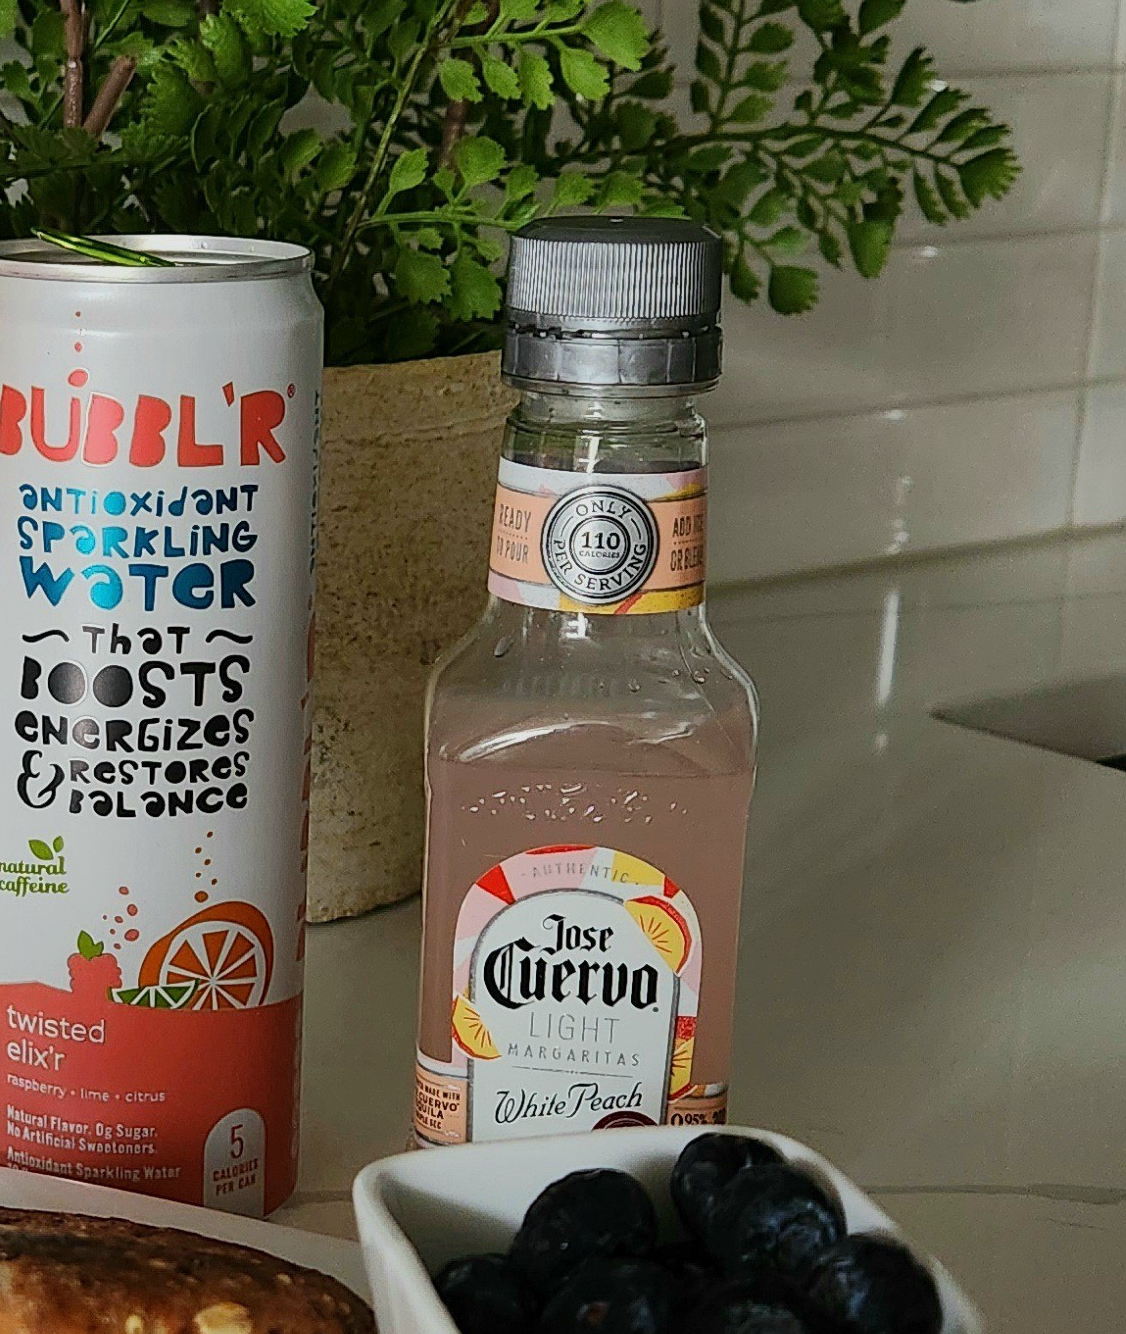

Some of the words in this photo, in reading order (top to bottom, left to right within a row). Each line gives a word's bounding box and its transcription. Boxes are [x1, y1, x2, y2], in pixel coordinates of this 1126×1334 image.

[499, 503, 532, 533] READY
[575, 499, 632, 520] ONLY
[581, 531, 621, 550] 110
[672, 515, 692, 538] ADD
[504, 539, 529, 564] POUR
[553, 539, 573, 576] PER
[573, 543, 647, 591] SERVING
[578, 550, 621, 559] CALORIES
[20, 655, 251, 708] BOOSTS
[532, 862, 631, 884] AUTHENTIC
[542, 913, 614, 954] Jose
[483, 936, 659, 1010] Cuervo
[7, 1004, 107, 1044] twisted
[529, 1011, 621, 1045] LIGHT
[6, 1039, 66, 1072] elix'r
[508, 1042, 641, 1067] MARGARITAS
[6, 1073, 67, 1100] raspberry
[80, 1087, 110, 1102] lime
[125, 1090, 167, 1103] citrus
[6, 1104, 48, 1128] Natural
[495, 1089, 567, 1125] White
[566, 1082, 643, 1118] Peach
[6, 1120, 21, 1138] No
[23, 1127, 75, 1151] Artificial
[230, 1123, 244, 1159] 5
[6, 1146, 73, 1175] Antioxidant
[76, 1162, 141, 1182] Sparkling
[143, 1166, 182, 1181] Water
[212, 1158, 259, 1182] CALORIES
[215, 1180, 234, 1196] PER
[238, 1172, 256, 1189] CAN
